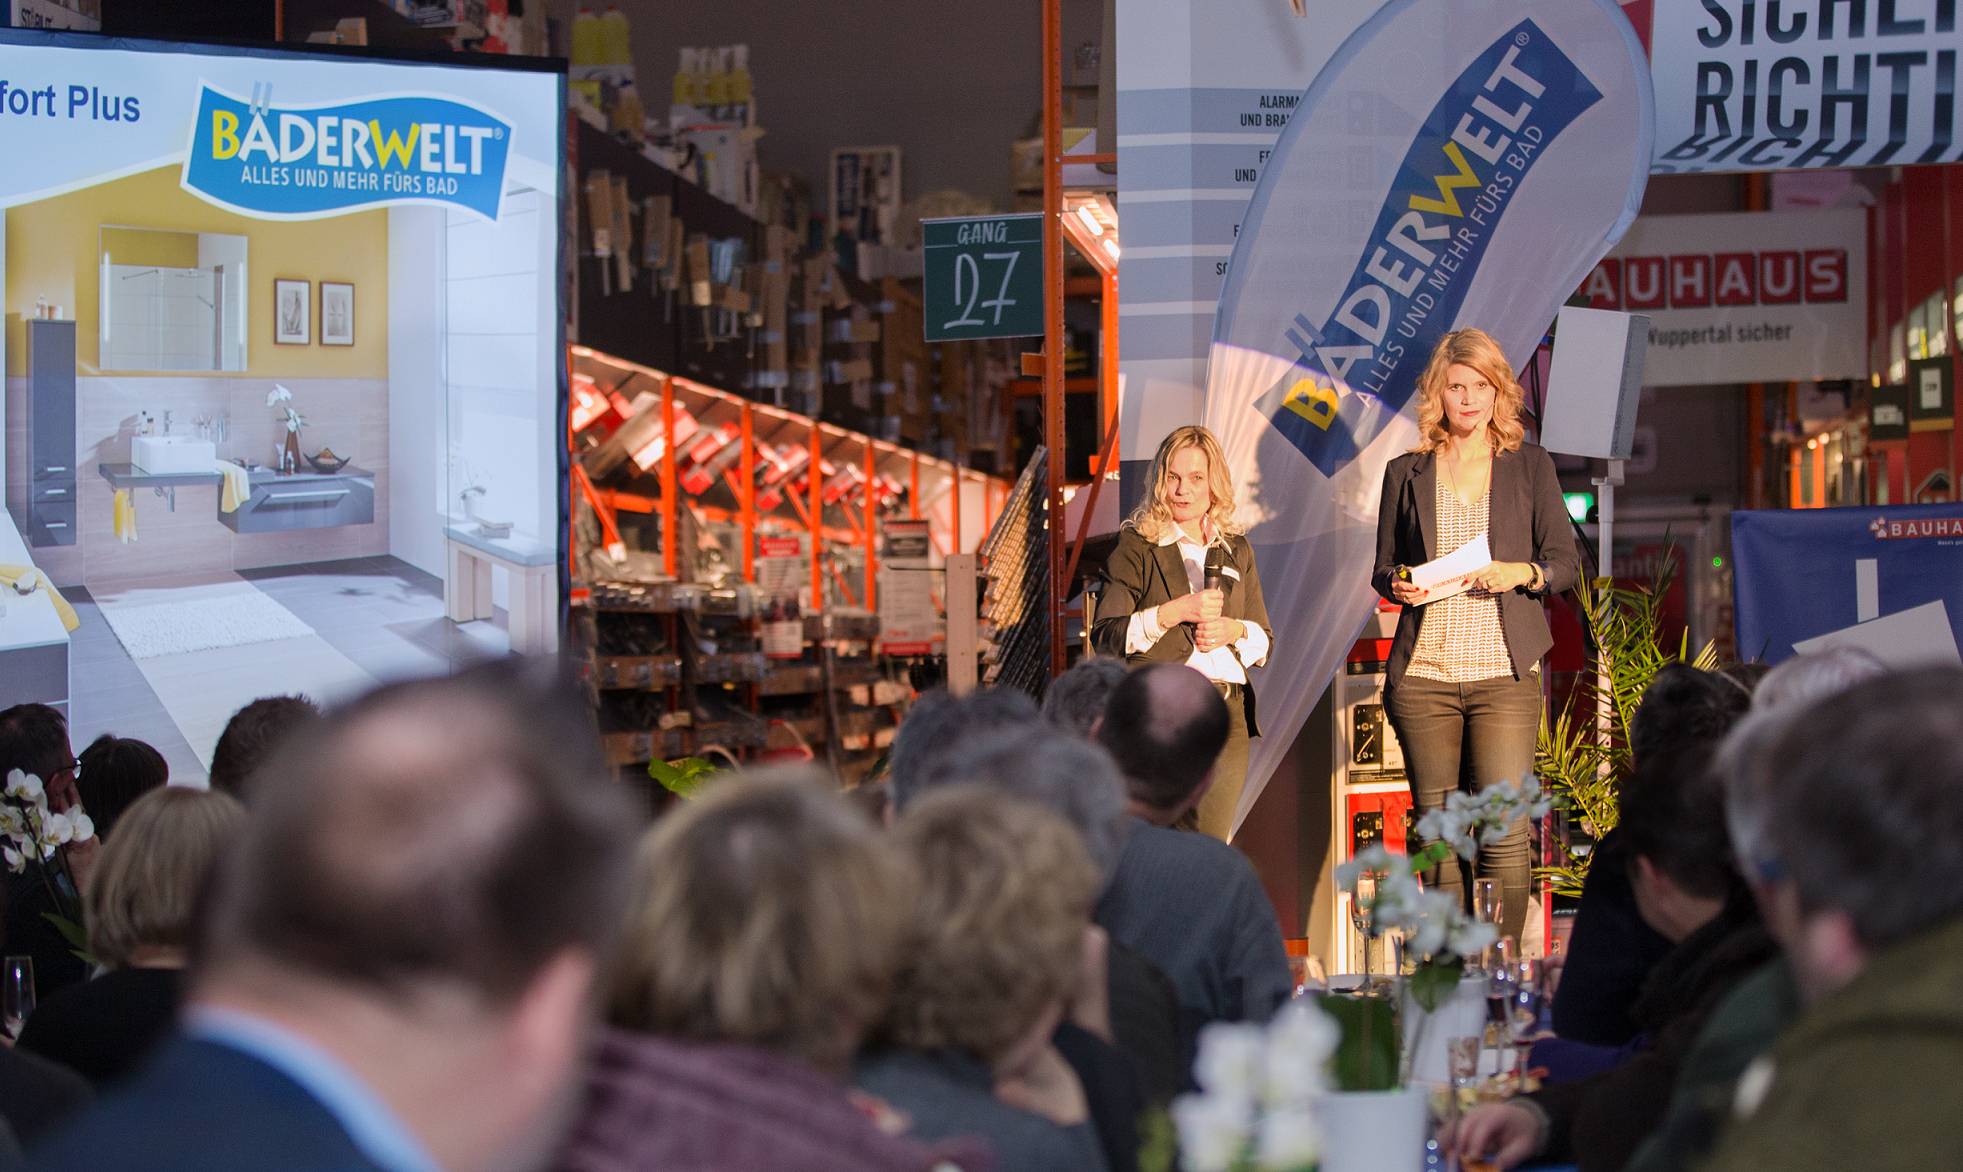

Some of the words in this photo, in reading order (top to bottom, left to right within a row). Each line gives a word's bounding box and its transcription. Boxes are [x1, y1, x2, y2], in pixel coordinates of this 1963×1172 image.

[68, 85, 141, 122] Plus
[1240, 113, 1261, 127] UND
[1265, 113, 1290, 127] BRA
[241, 167, 289, 186] ALLES
[294, 169, 328, 188] UND
[333, 171, 379, 190] MEHR
[384, 173, 421, 194] FÜRS
[426, 176, 458, 196] BAD
[1235, 169, 1257, 182] UND
[957, 222, 1008, 245] GANG
[1356, 340, 1404, 408] ALLES
[1397, 292, 1435, 339] UND
[1428, 227, 1479, 291] MEHR
[1469, 171, 1514, 226] FÜRS
[1506, 126, 1543, 171] BAD
[1580, 255, 1840, 302] AUHAUS
[944, 251, 1020, 329] 27
[1736, 322, 1792, 342] sicher
